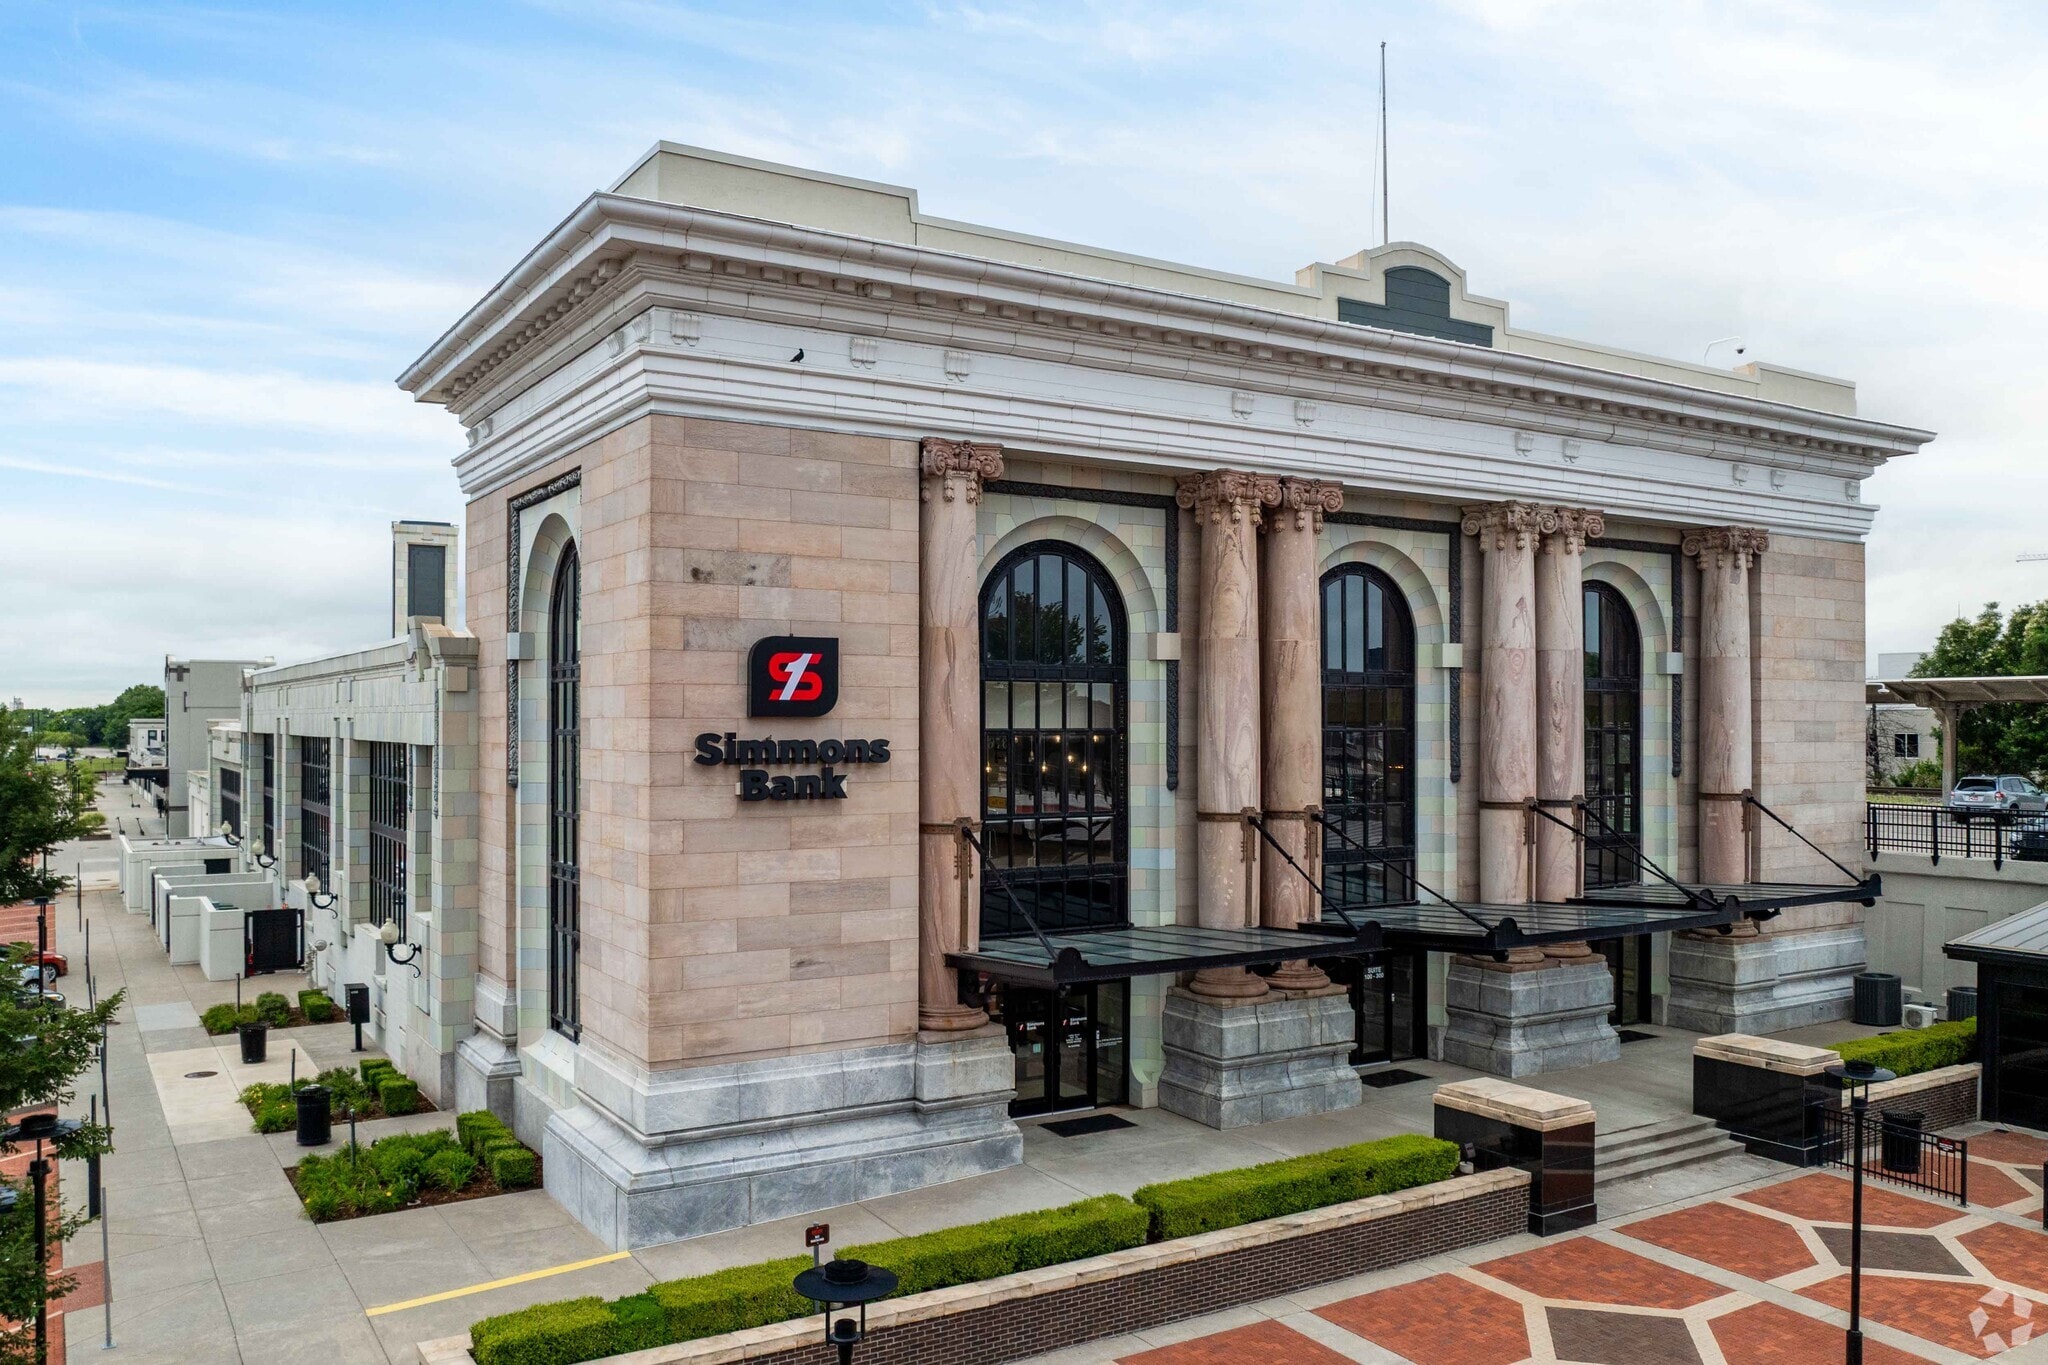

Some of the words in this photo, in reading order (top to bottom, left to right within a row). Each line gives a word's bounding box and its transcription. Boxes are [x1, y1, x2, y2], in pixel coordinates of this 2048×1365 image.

[694, 732, 891, 766] Simmons
[740, 767, 848, 801] Bank
[1367, 966, 1382, 974] SUITE
